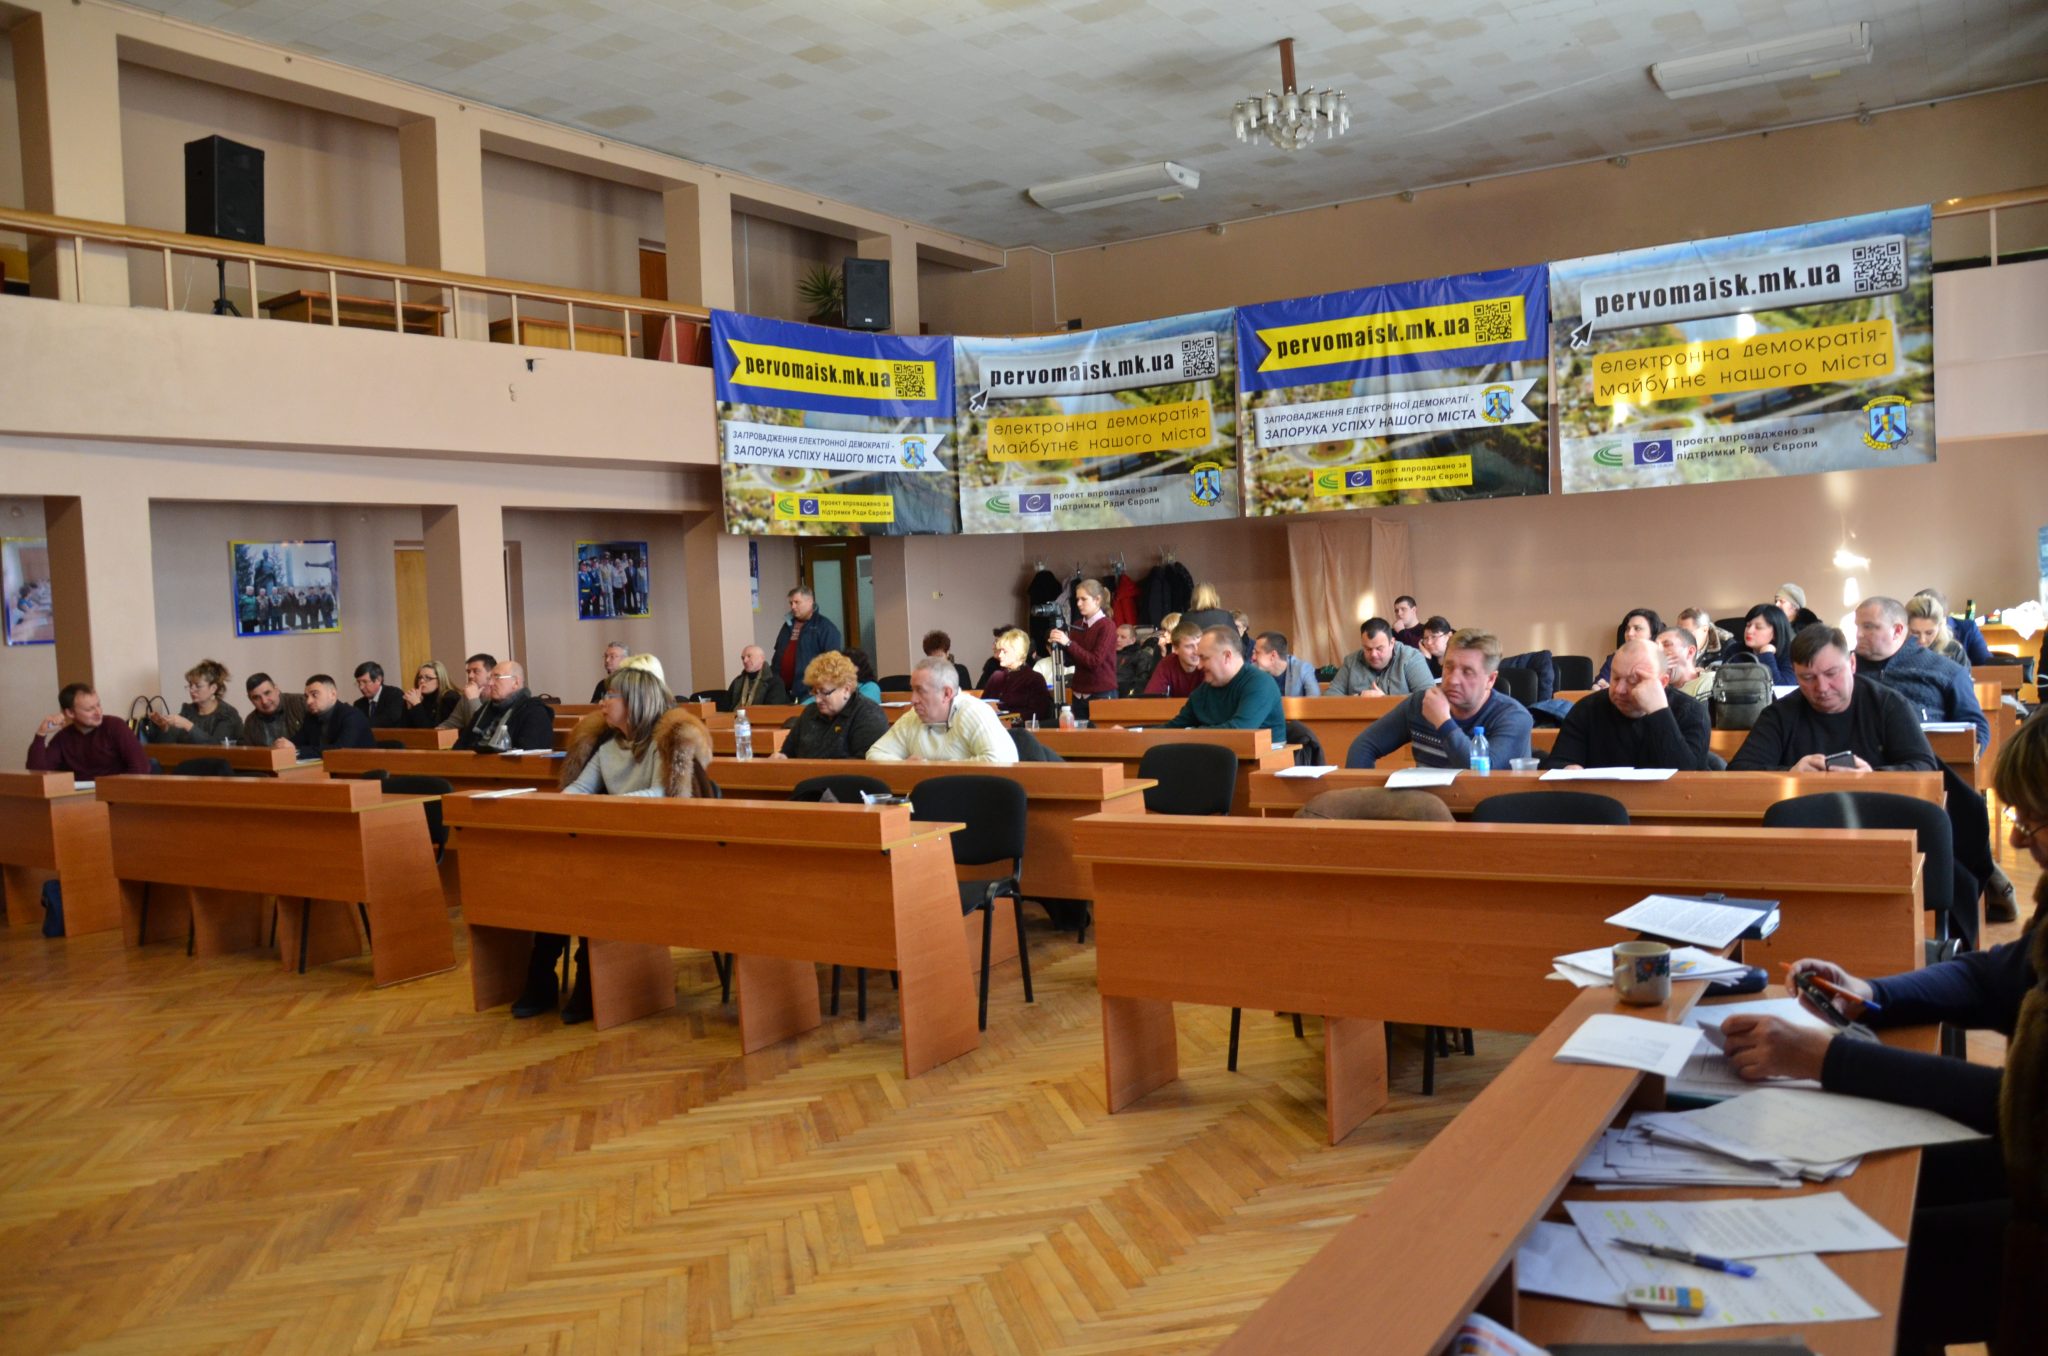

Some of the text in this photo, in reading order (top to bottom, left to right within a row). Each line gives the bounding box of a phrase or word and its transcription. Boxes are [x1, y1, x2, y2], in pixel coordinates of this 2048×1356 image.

[1594, 262, 1842, 318] pervomaisk.mk.ua
[1276, 316, 1471, 359] pervomaisk.mk.ua
[745, 355, 891, 388] pervomaisk.mk.ua
[990, 353, 1175, 388] pervomaisk.mk.ua
[1600, 344, 1730, 375] електронна
[1600, 351, 1888, 398] майбутнє нашого міста
[1263, 408, 1344, 425] ЗАПРОВАДЖЕННЯ
[1346, 399, 1411, 415] ЕЛЕКТРОННОЇ
[1412, 393, 1469, 409] ДЕМОКРАТІЇ
[732, 430, 797, 444] ЗАПРОВАДЖЕННЯ
[799, 437, 847, 447] ЕЛЕКТРОННОЇ
[848, 440, 891, 449] ДЕМОКРАТІЇ
[993, 418, 1098, 437] електронна
[1264, 408, 1477, 441] ЗАПОРУКА УСПІХУ НАШОГО МІСТА
[1675, 436, 1716, 447] проект
[1719, 428, 1799, 443] впроваджено
[1802, 426, 1816, 434] за
[733, 444, 897, 465] ЗАПОРУКА УСПІХУ НАШОГО МІСТА
[992, 426, 1207, 456] майбутнє нашого міста
[1676, 440, 1819, 460] підтримки Ради Європи
[1054, 497, 1160, 511] підтримки Ради Європи
[1087, 487, 1146, 498] впроваджено
